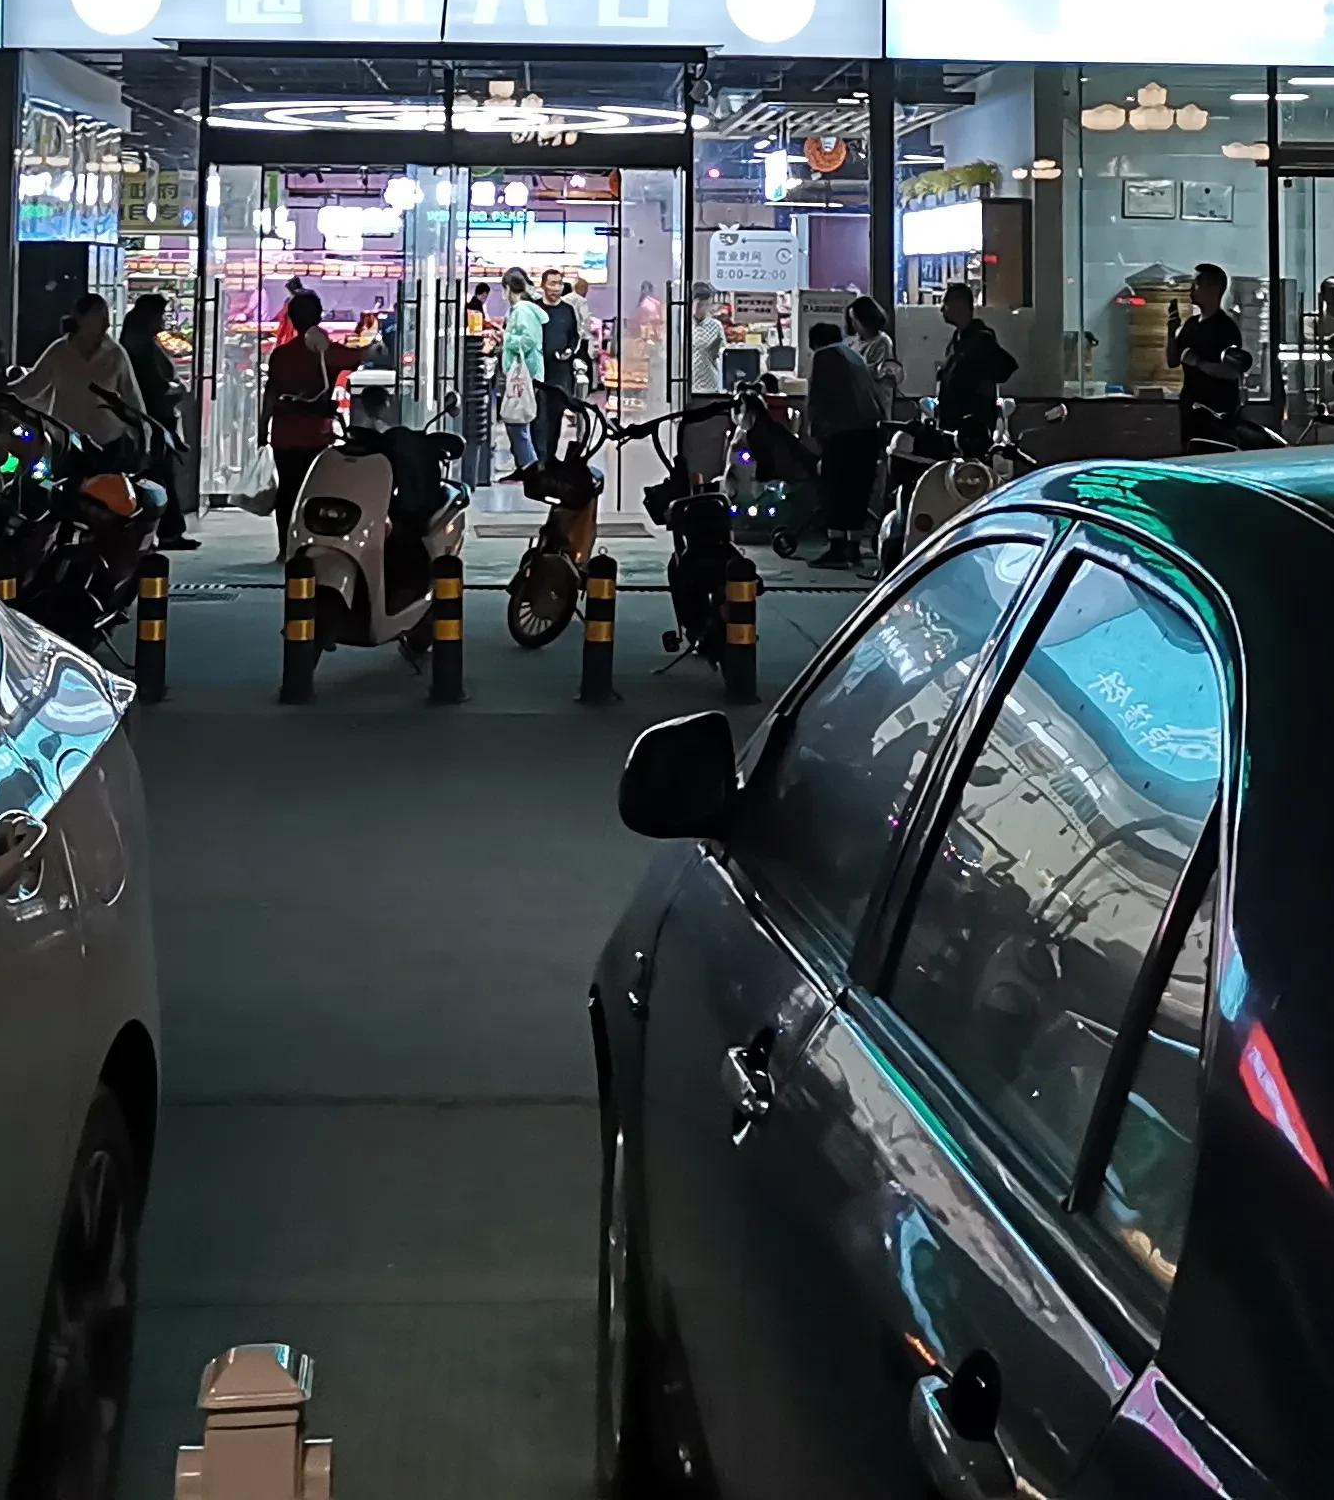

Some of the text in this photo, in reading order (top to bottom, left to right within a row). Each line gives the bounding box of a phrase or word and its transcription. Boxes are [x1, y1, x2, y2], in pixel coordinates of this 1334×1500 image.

[716, 250, 762, 263] 营业时间
[716, 268, 787, 281] 8:00-22:00
